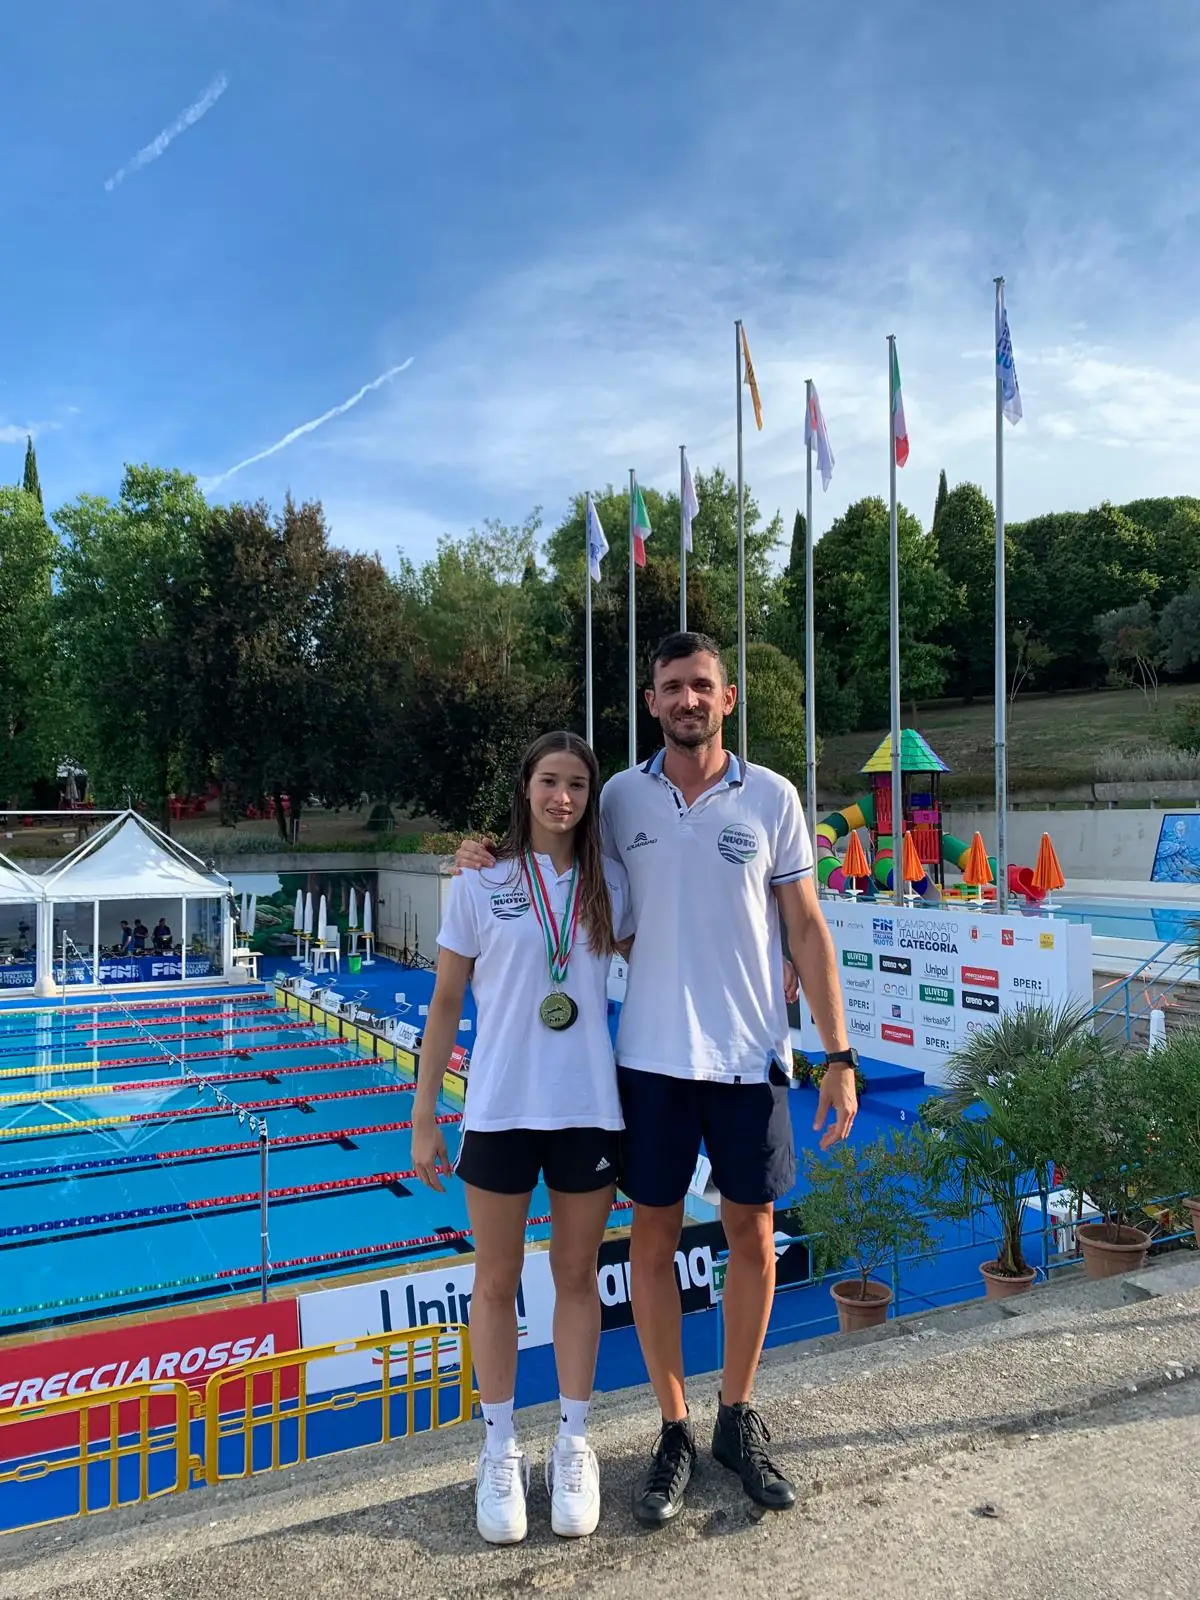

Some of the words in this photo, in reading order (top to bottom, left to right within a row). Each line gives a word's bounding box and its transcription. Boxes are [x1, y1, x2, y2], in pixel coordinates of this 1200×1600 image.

[722, 835, 756, 848] NUOTO
[493, 897, 527, 906] NUOTO
[899, 918, 959, 934] CAMPIONATO
[900, 928, 940, 942] ITALIANO
[941, 932, 951, 943] DI
[900, 939, 959, 954] CATEGORIA
[847, 952, 868, 963] ULIVETO
[98, 964, 132, 979] FIN
[925, 962, 949, 978] Unipol
[883, 983, 908, 997] enel
[924, 987, 949, 997] ULIVETO
[965, 996, 983, 1006] arena
[389, 1020, 396, 1031] 4
[851, 1018, 871, 1033] Unipol
[900, 1110, 906, 1121] 3
[0, 1333, 276, 1409] FRECCIAROSSA
